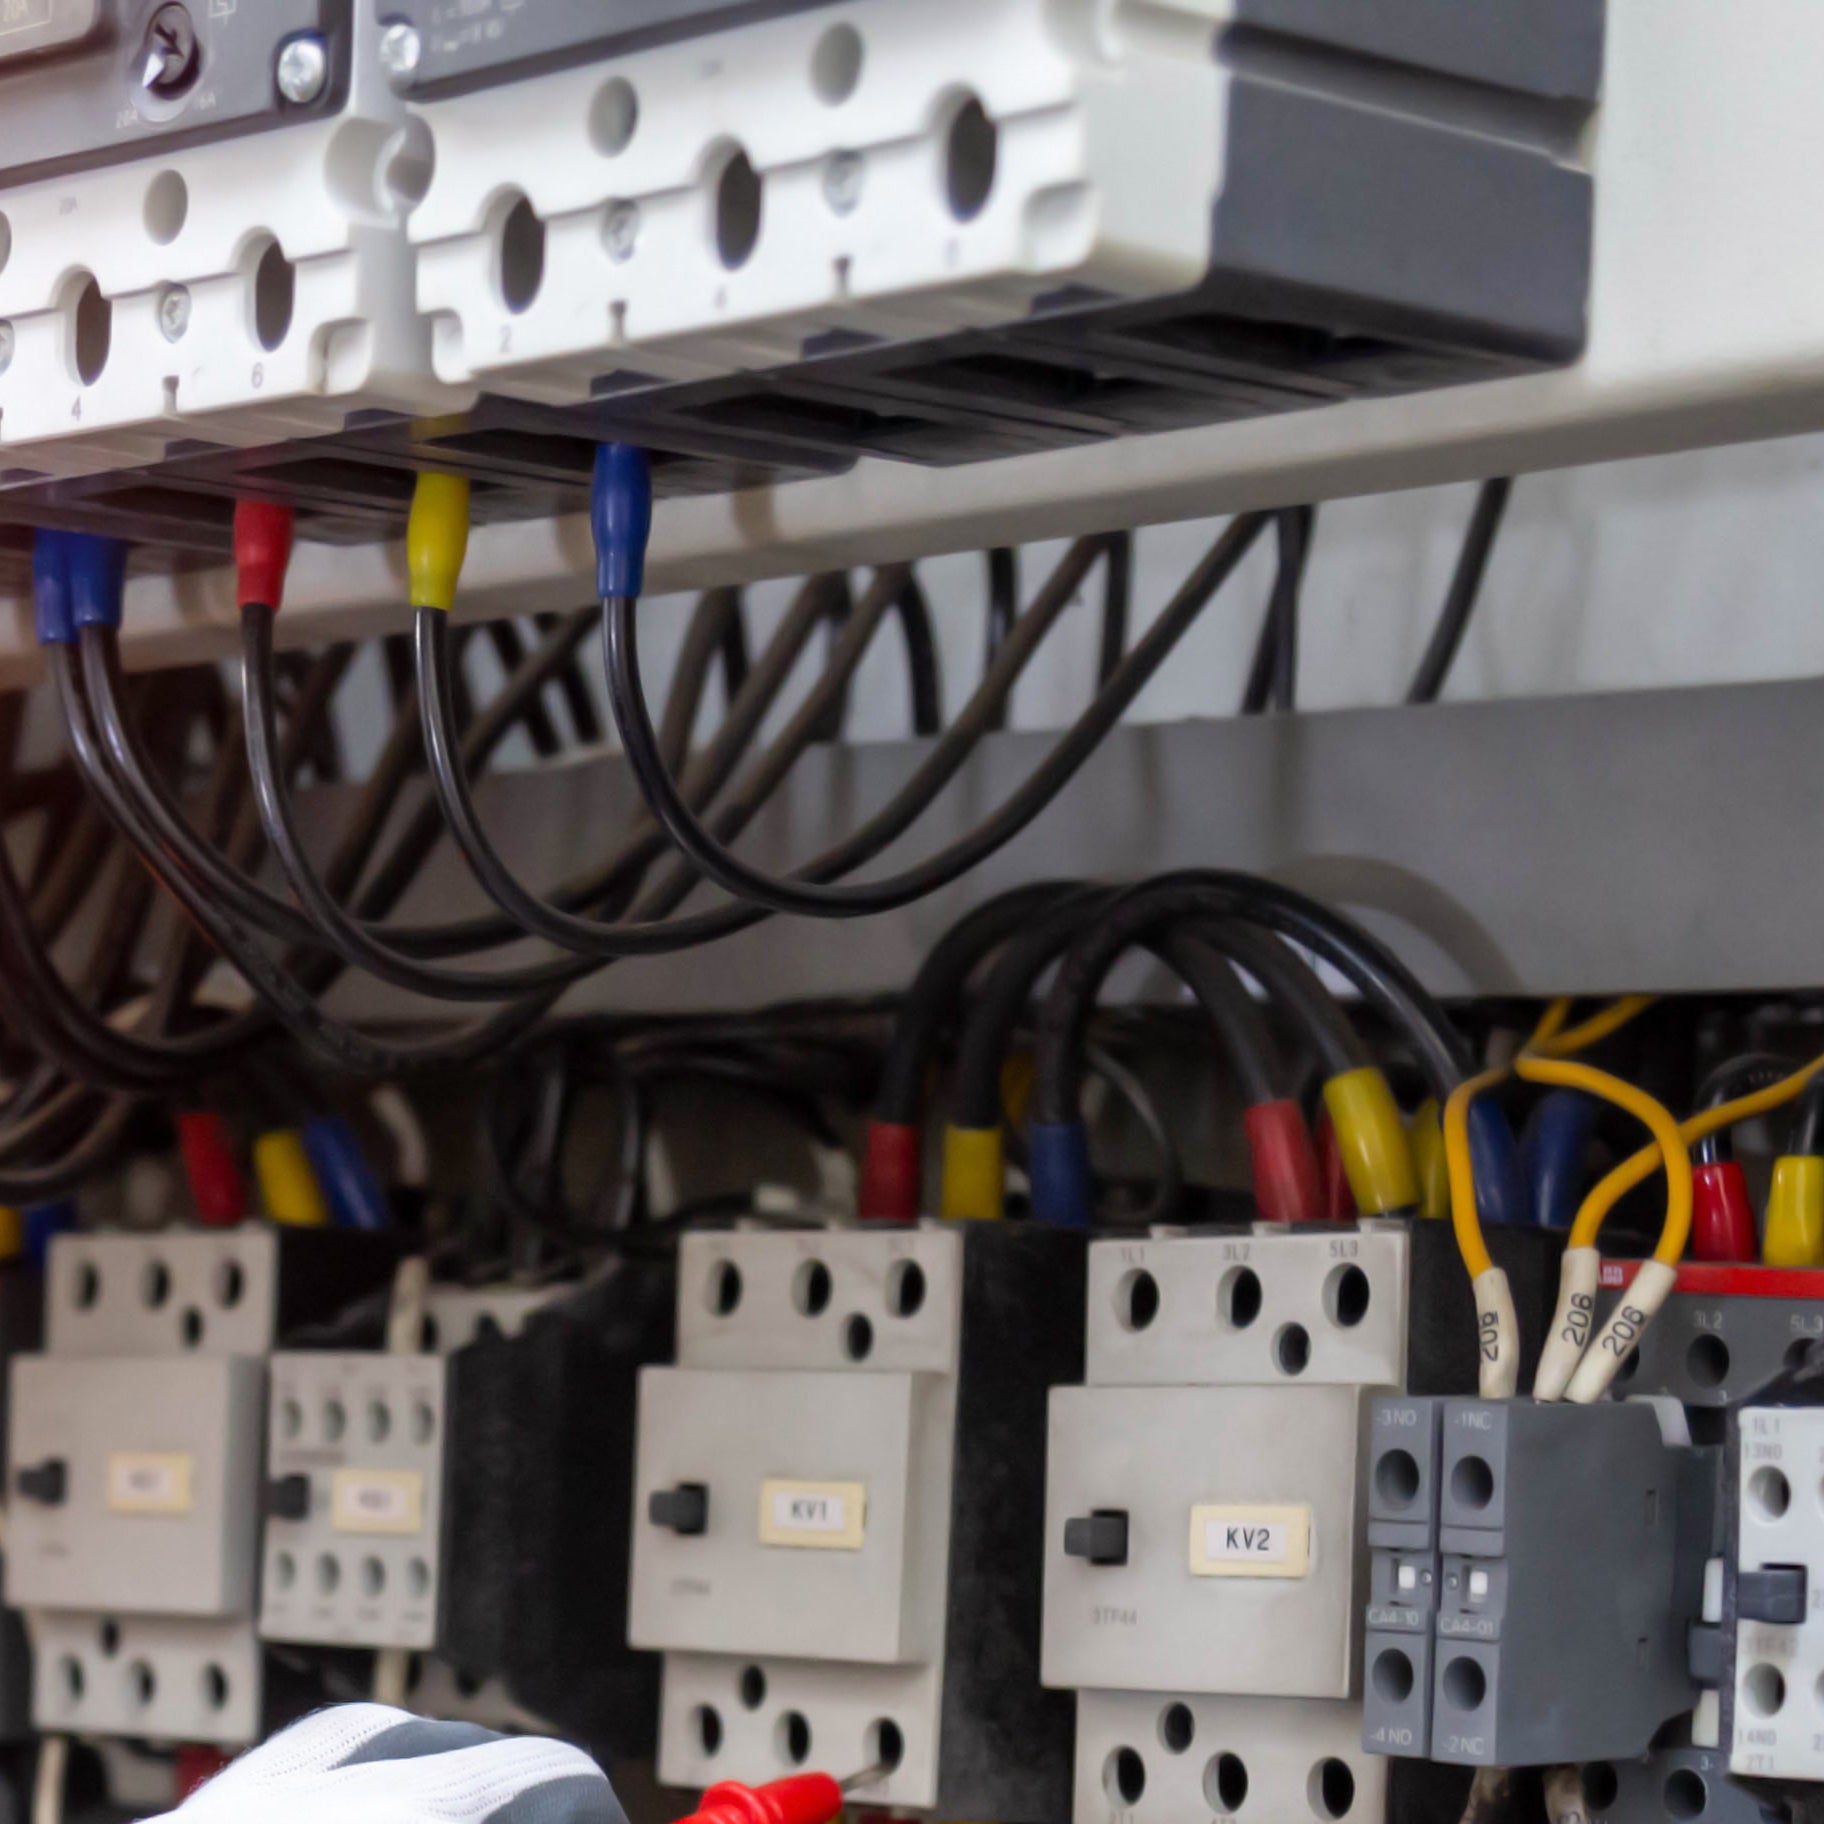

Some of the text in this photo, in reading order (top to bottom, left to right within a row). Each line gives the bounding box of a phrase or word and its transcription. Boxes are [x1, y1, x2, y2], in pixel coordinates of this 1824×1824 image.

[251, 362, 265, 390] 6
[70, 395, 82, 422] 4
[1600, 1265, 1624, 1285] BB
[1561, 1292, 1593, 1347] 206
[1602, 1305, 1645, 1357] 206
[790, 1500, 829, 1521] KV1
[1226, 1526, 1271, 1552] KV2
